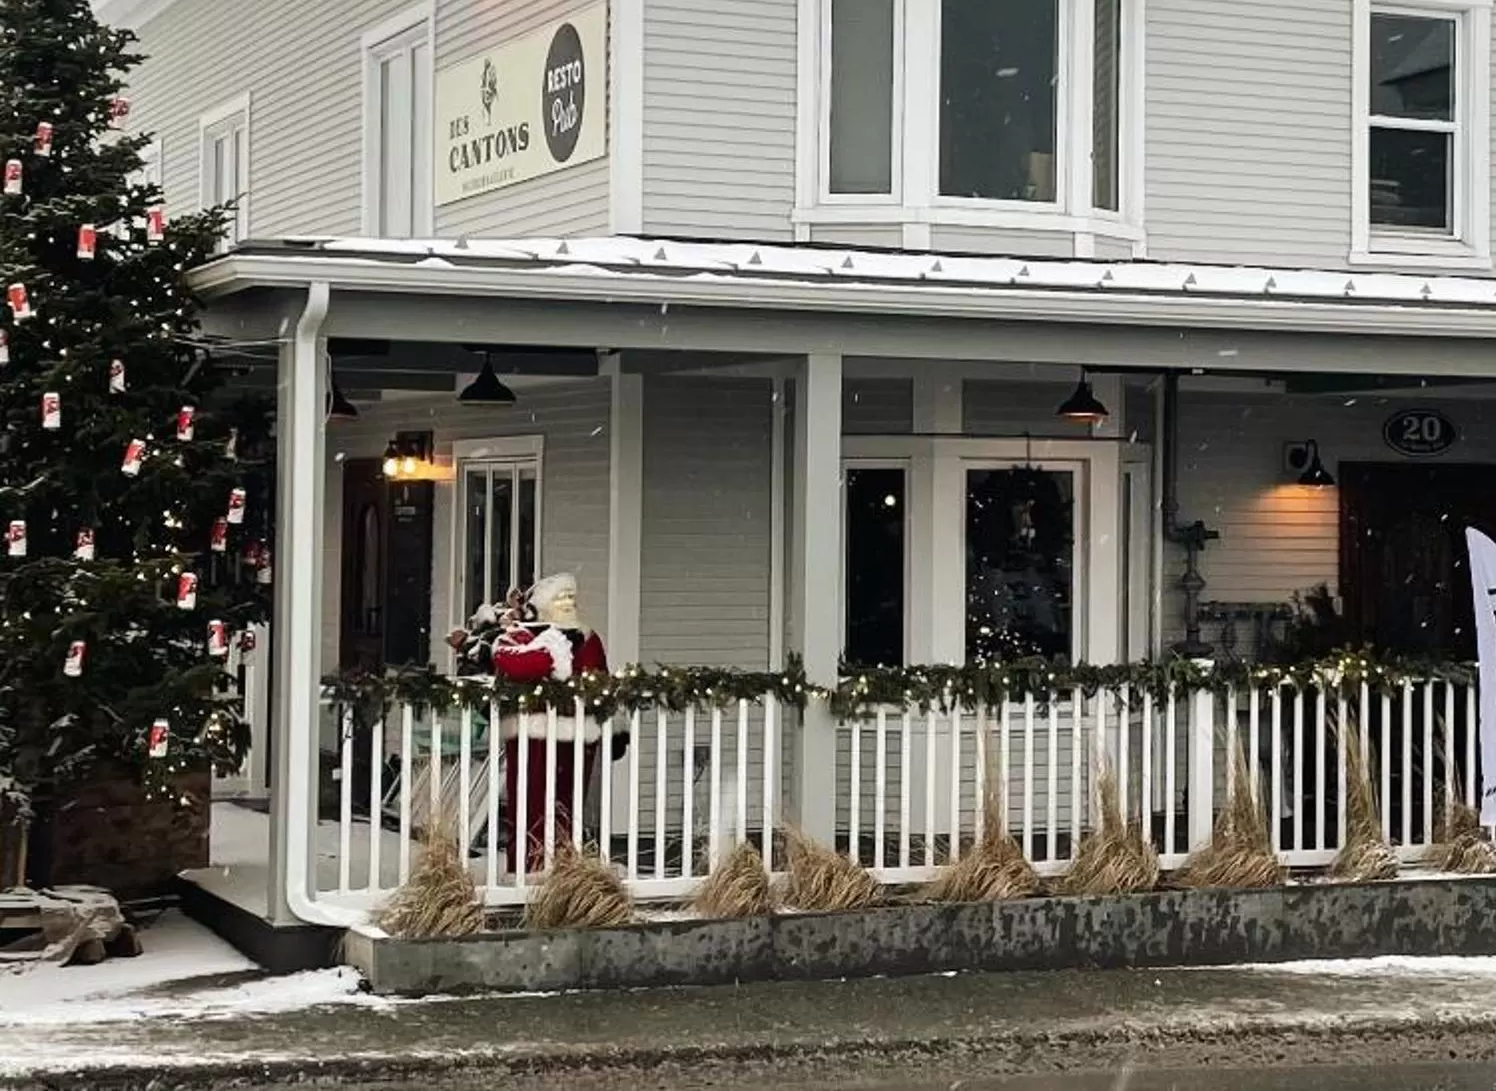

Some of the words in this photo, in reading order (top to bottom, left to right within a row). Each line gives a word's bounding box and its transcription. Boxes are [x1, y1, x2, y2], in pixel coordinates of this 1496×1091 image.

[547, 59, 581, 93] RESTO
[551, 90, 579, 136] Pub
[449, 122, 530, 173] CANTONS
[1402, 415, 1441, 441] 20
